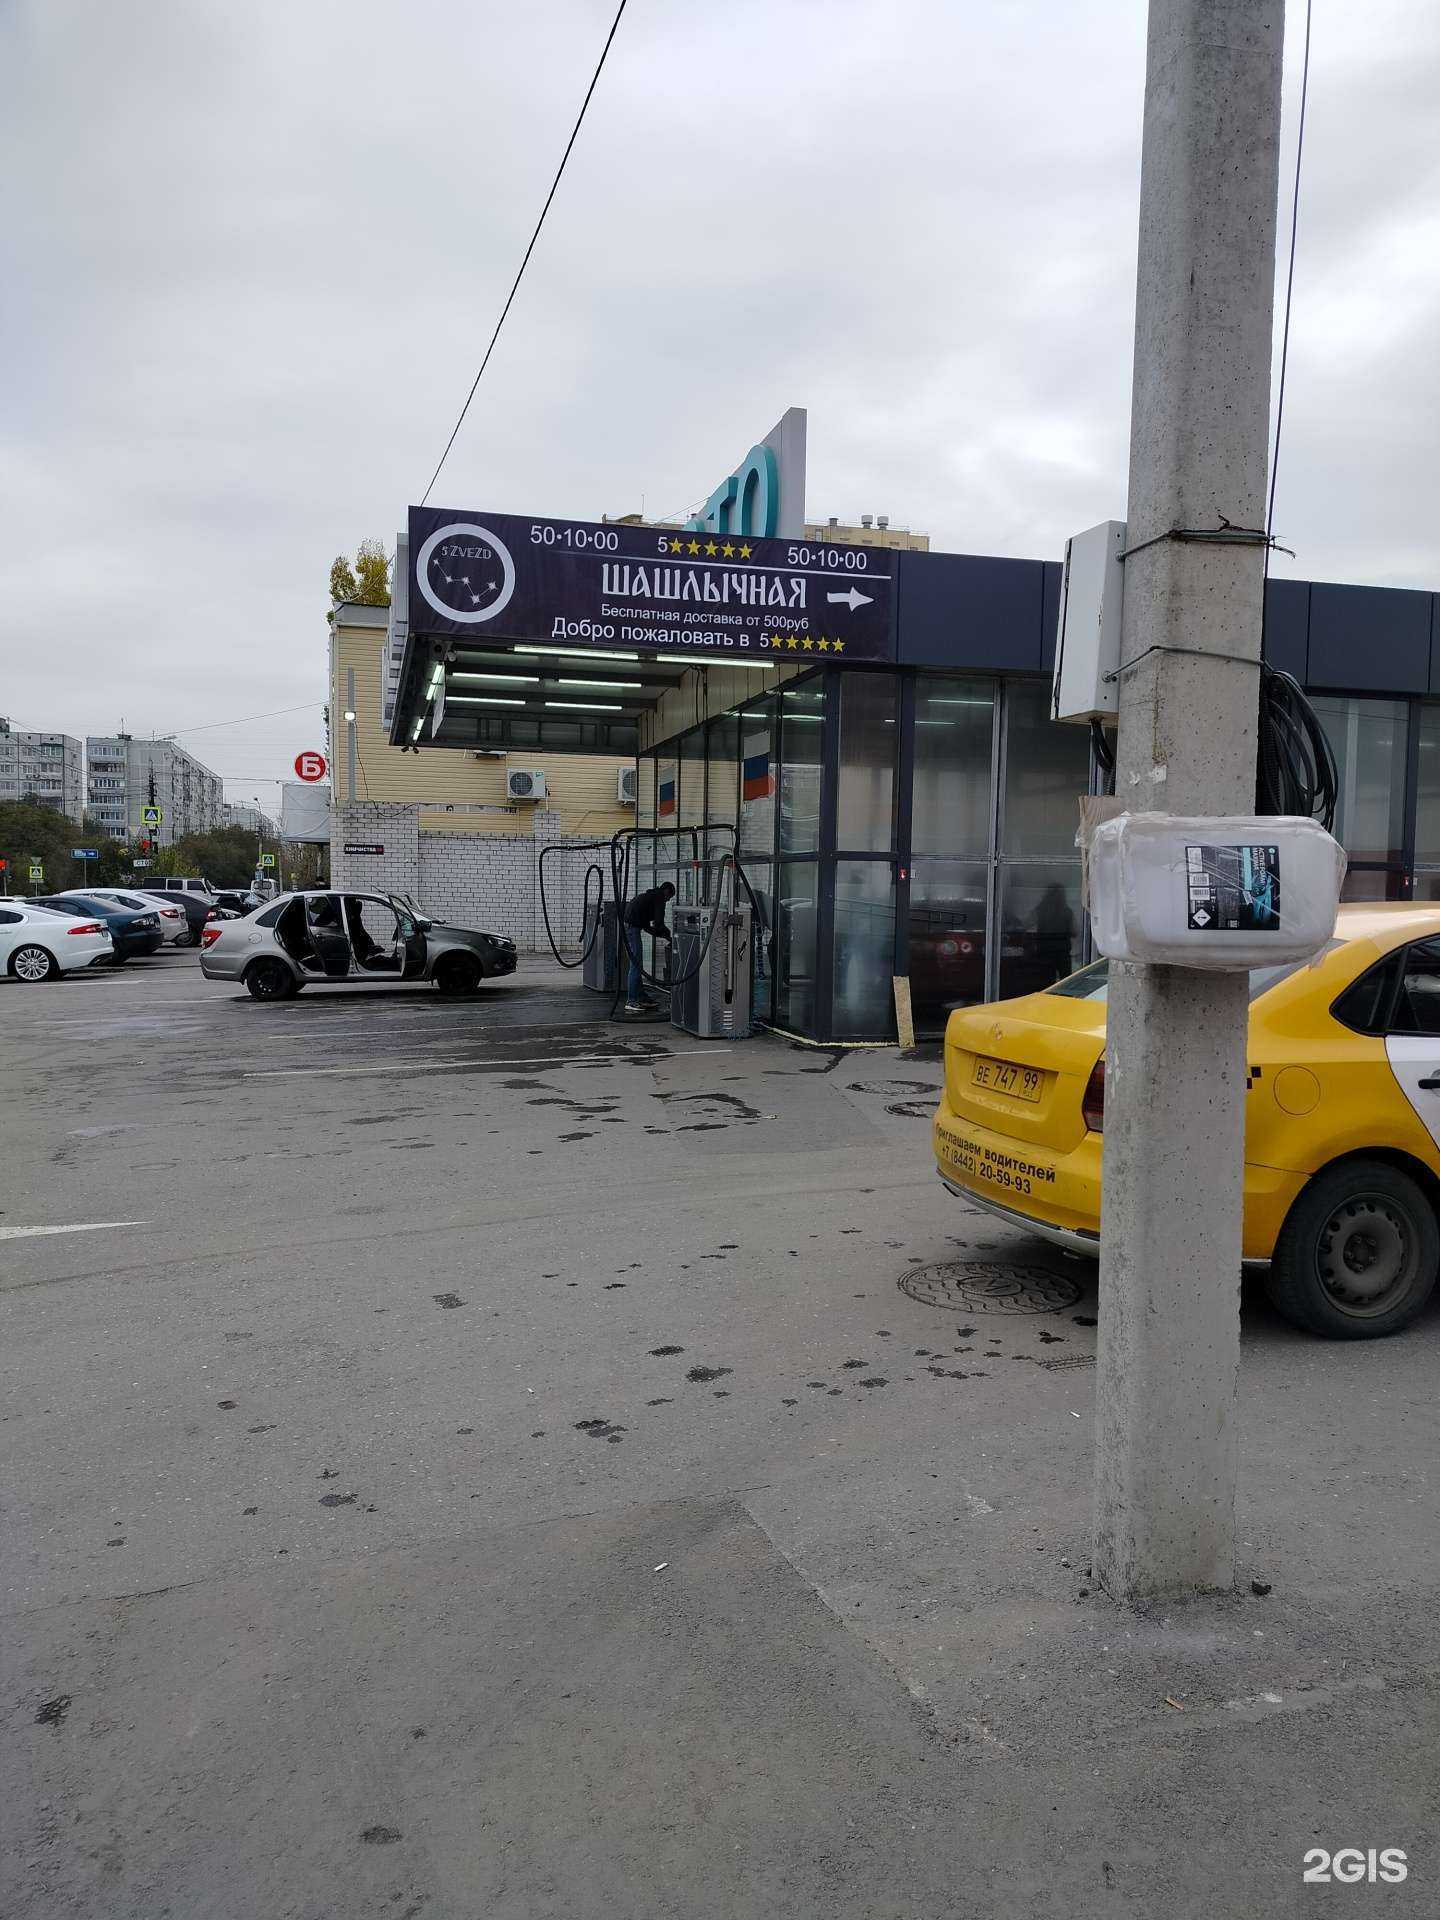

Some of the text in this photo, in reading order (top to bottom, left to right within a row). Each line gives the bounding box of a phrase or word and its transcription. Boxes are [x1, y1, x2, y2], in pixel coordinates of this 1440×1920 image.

[450, 545, 492, 559] ZVEZD
[602, 563, 807, 608] ШАШЛЫЧНАЯ
[551, 616, 615, 641] Добро
[621, 626, 734, 647] пожаловать
[739, 633, 750, 647] в
[601, 603, 809, 632] Бесплатная доставка от 500руб
[302, 756, 321, 777] Б
[994, 1066, 1018, 1091] 747
[1023, 1072, 1039, 1091] 99
[936, 1123, 1056, 1183] Приглашаем водителей
[942, 1145, 1031, 1194] +7 (8442) 20-59-93
